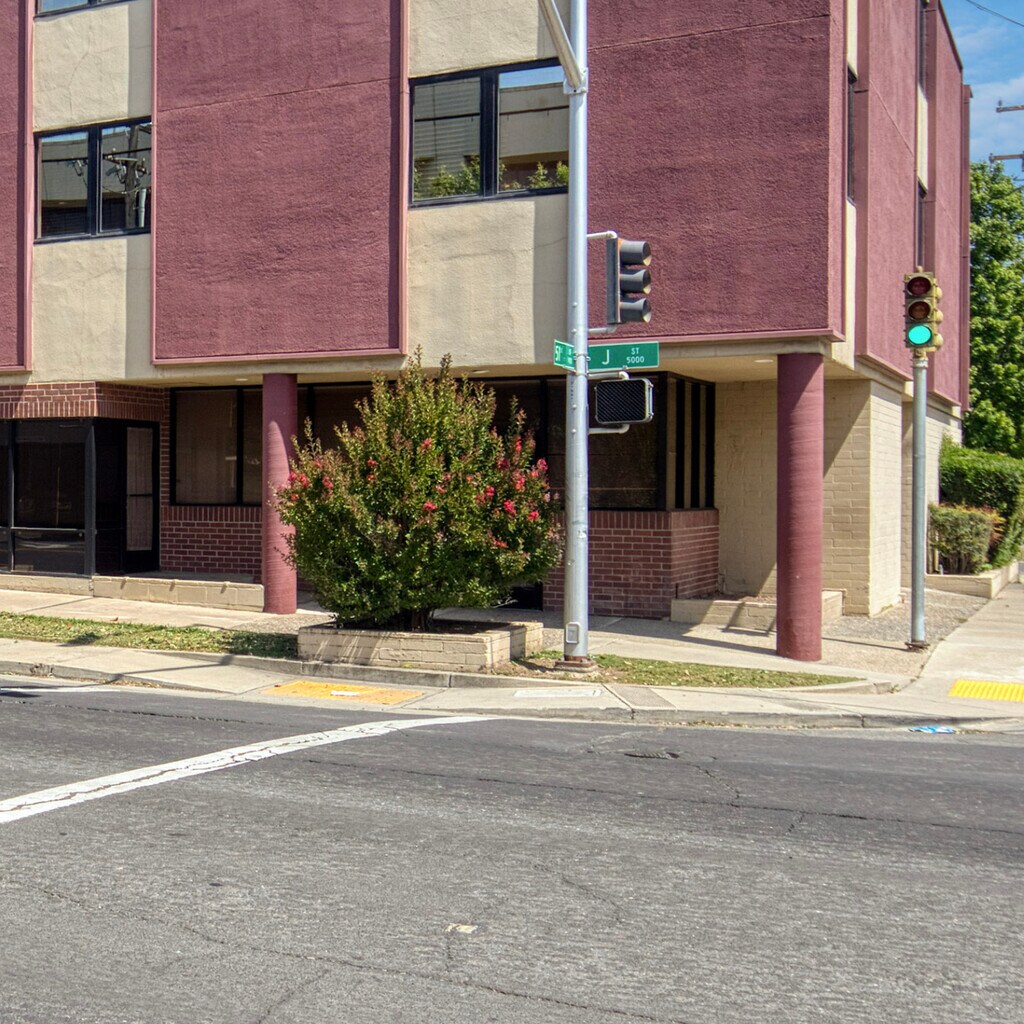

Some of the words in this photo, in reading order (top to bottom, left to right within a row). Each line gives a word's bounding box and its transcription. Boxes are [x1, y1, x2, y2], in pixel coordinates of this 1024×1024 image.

[631, 347, 640, 355] ST
[601, 349, 610, 365] J
[626, 356, 645, 364] 5000
